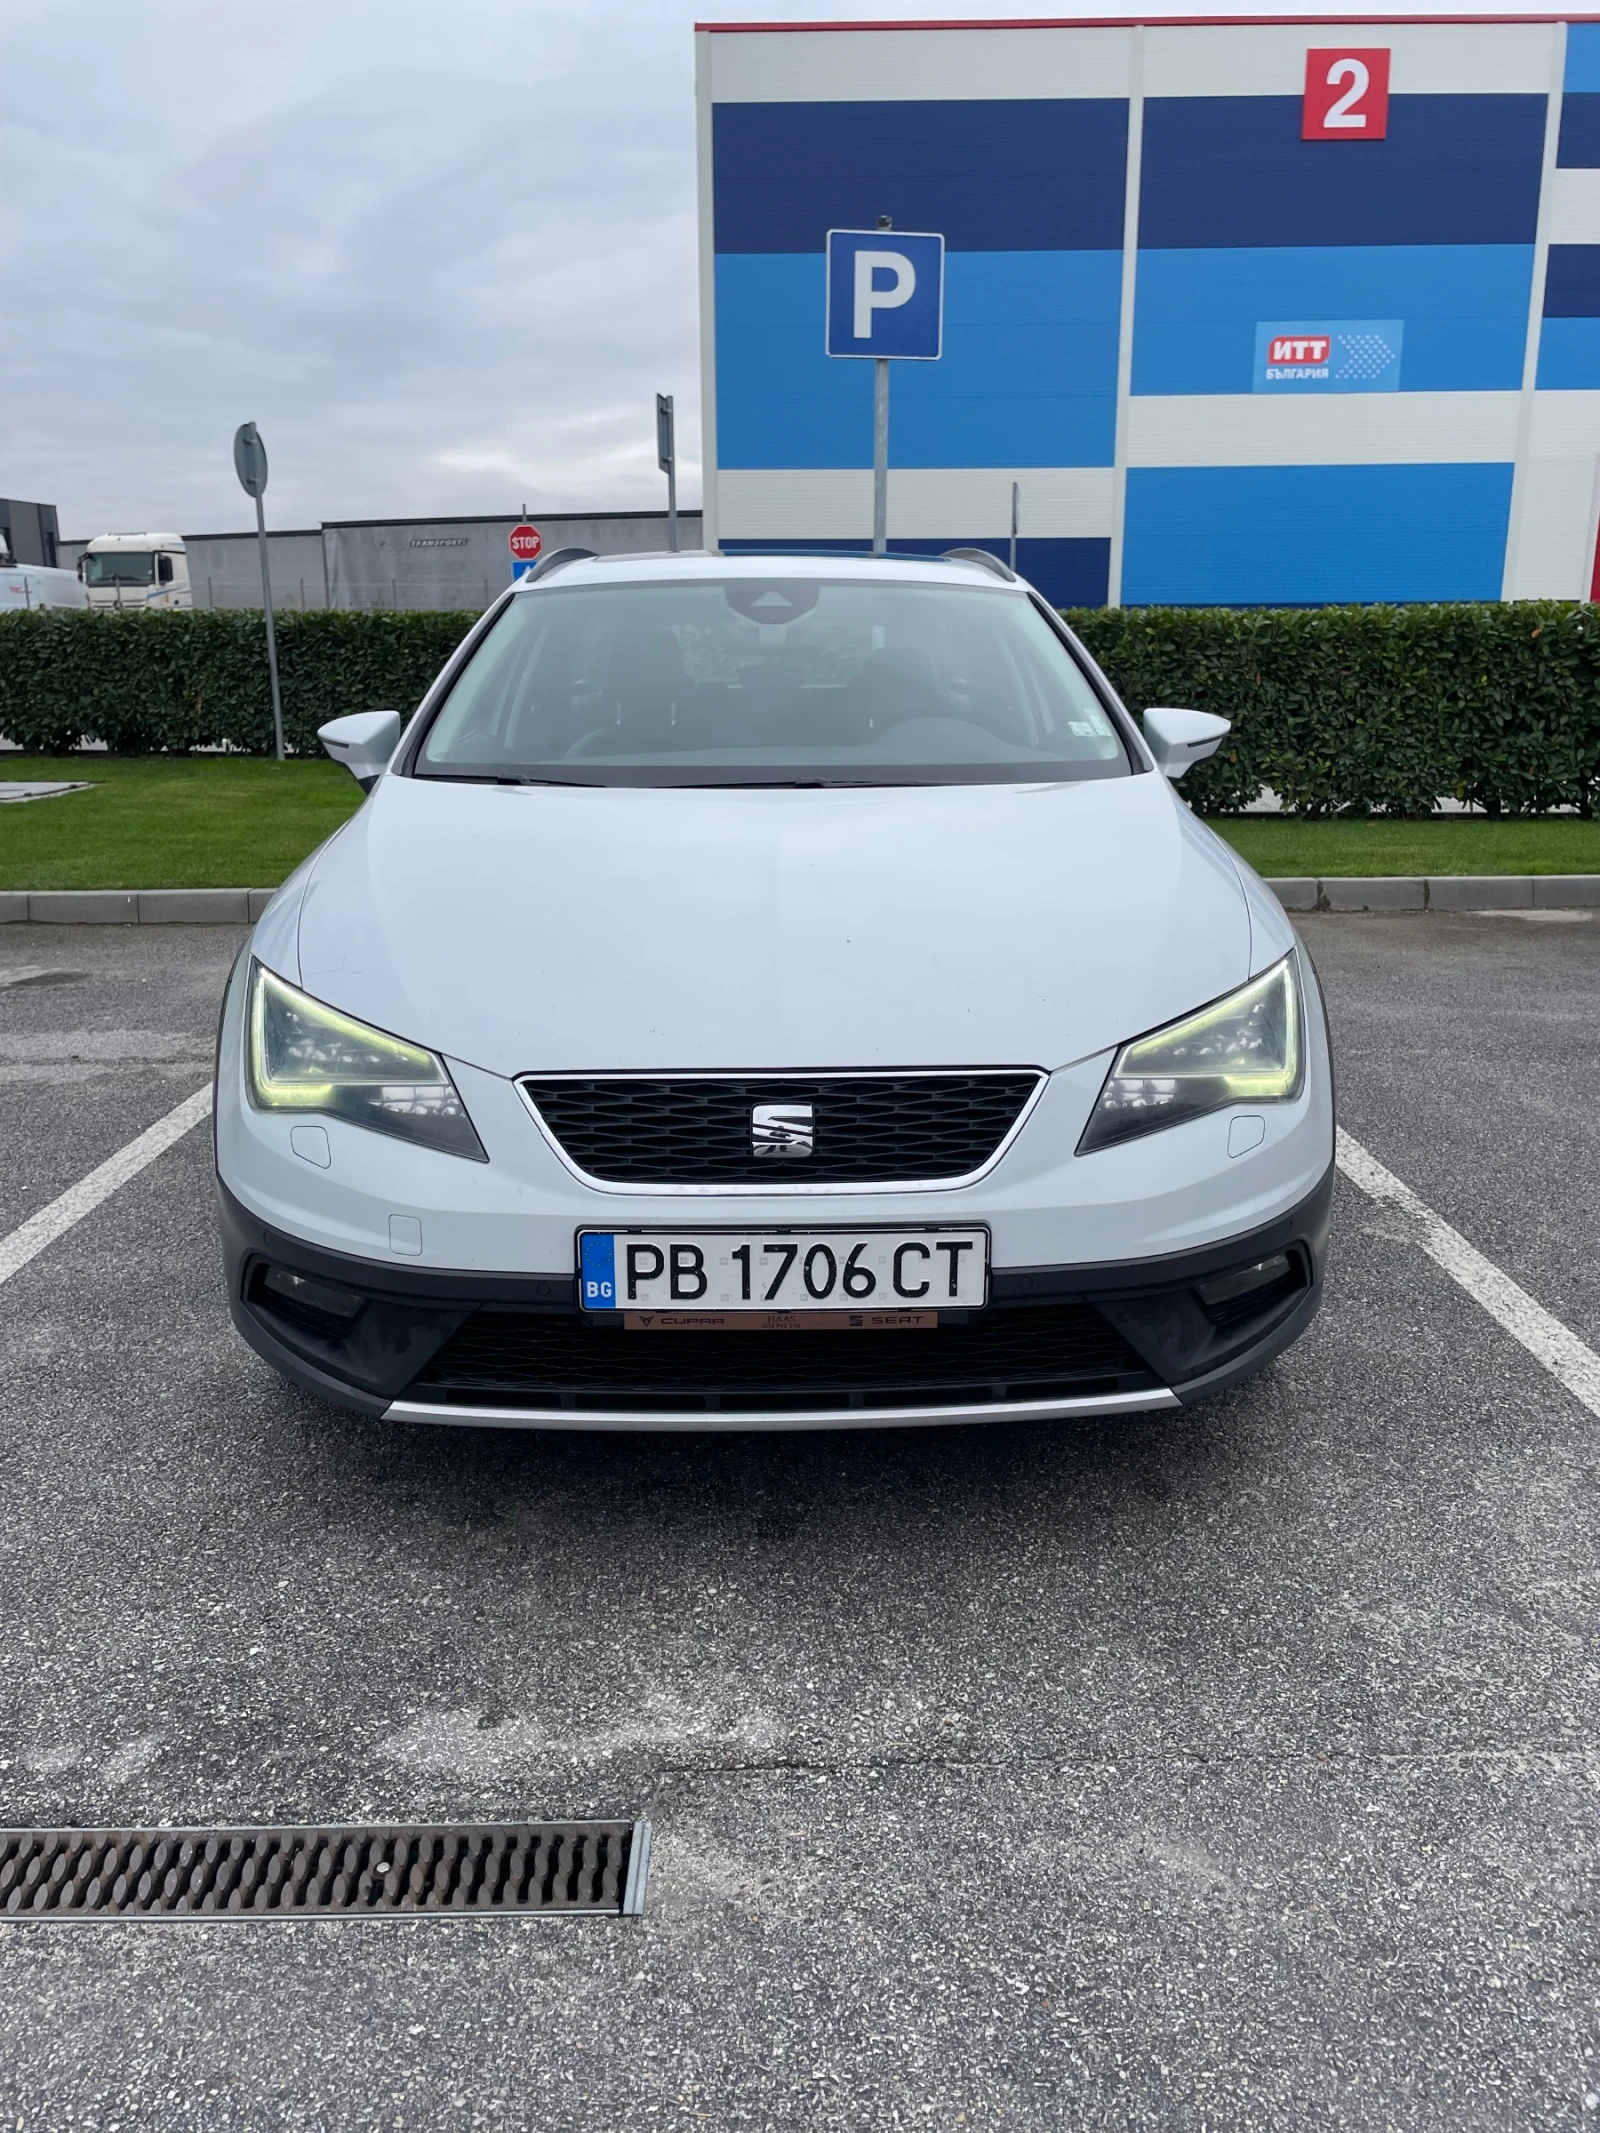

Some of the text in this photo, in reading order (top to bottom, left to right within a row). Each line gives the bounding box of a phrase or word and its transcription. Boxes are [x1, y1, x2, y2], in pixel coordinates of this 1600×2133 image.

[1323, 58, 1370, 128] 2
[853, 250, 917, 339] P
[1273, 340, 1327, 360] ИТТ
[1266, 367, 1329, 380] БЪЛГАРИЯ
[411, 538, 463, 547] TRANSPORT
[511, 536, 539, 550] STOP
[626, 1241, 974, 1301] PB 1706 CT
[586, 1281, 613, 1299] BG
[661, 1317, 724, 1325] CUPRA
[871, 1316, 924, 1324] SEAT
